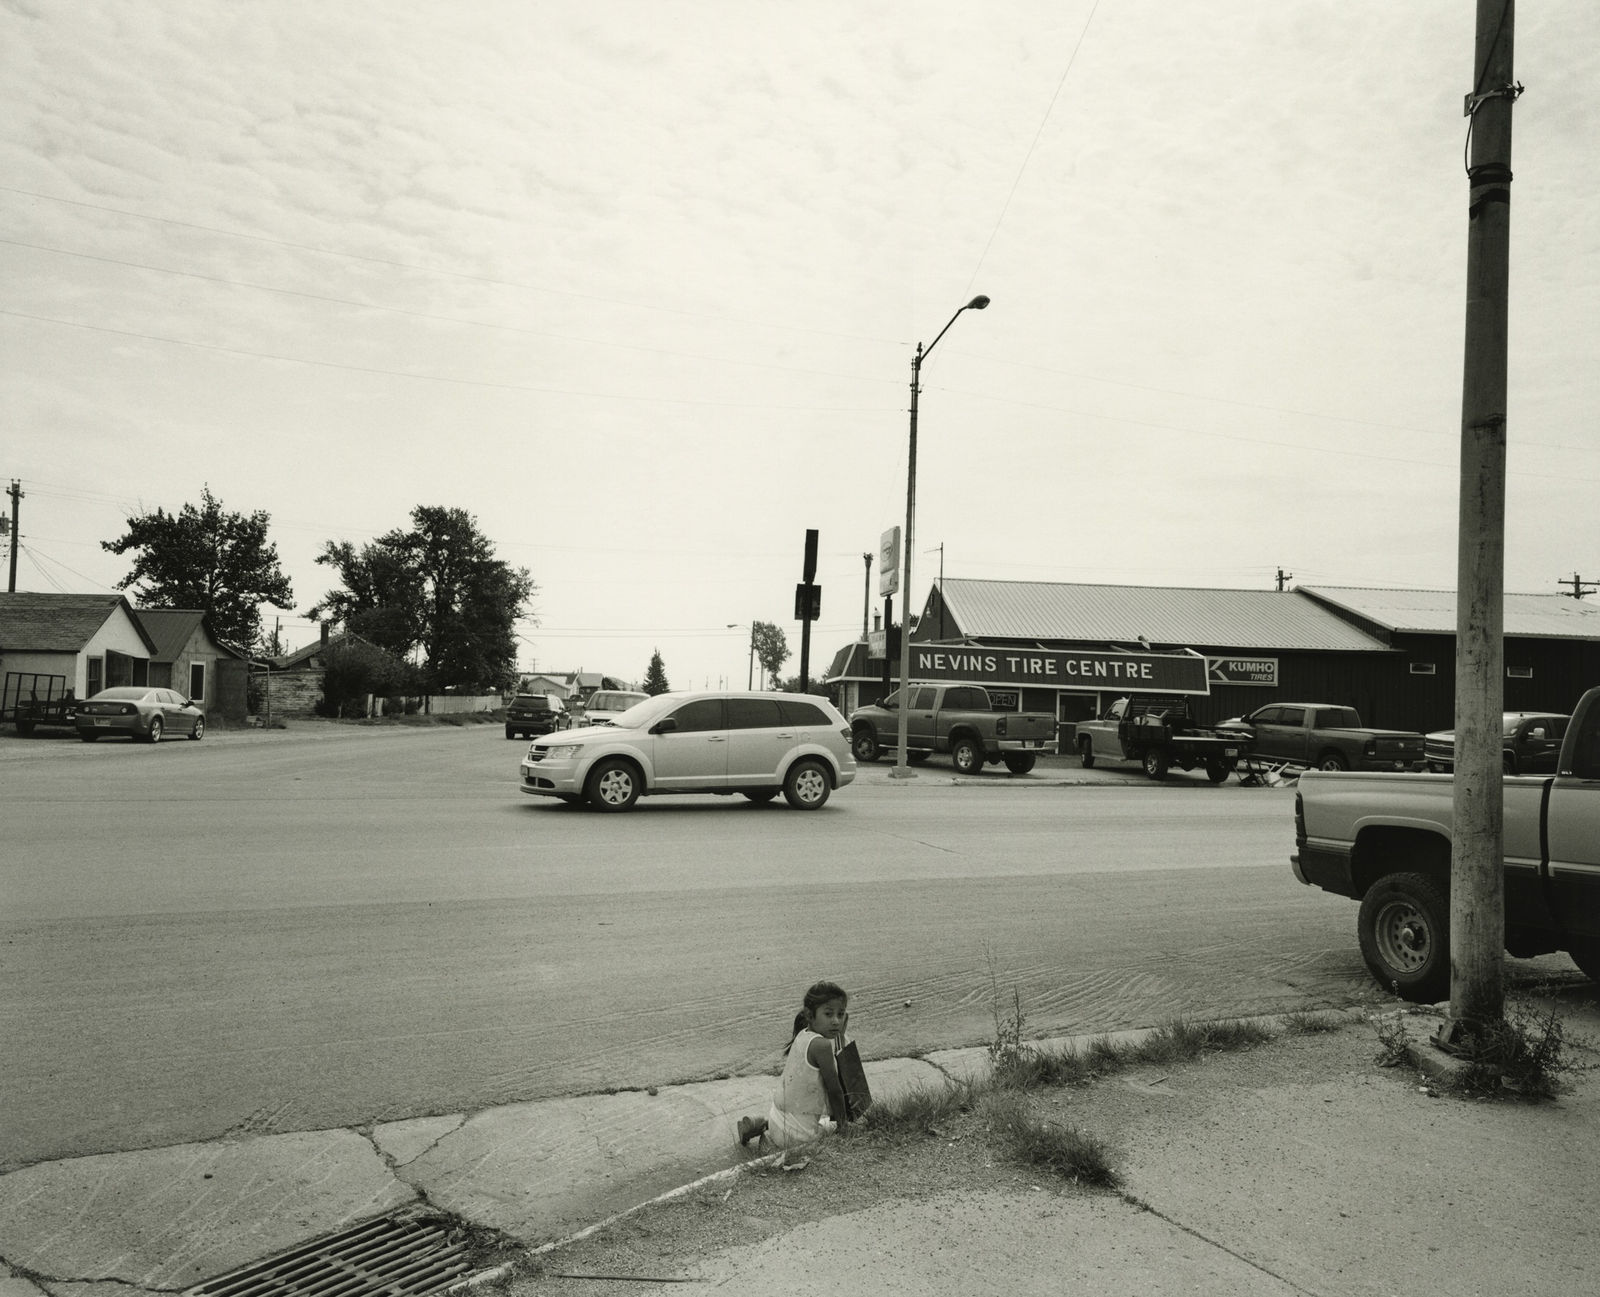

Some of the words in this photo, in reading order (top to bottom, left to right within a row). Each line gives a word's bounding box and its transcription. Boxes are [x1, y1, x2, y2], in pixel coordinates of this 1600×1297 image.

[919, 653, 997, 672] NEVINS
[1006, 657, 1057, 675] TIRE
[1066, 660, 1153, 678] CENTRE
[1229, 661, 1274, 673] KUMHO
[1250, 673, 1273, 681] TIRES
